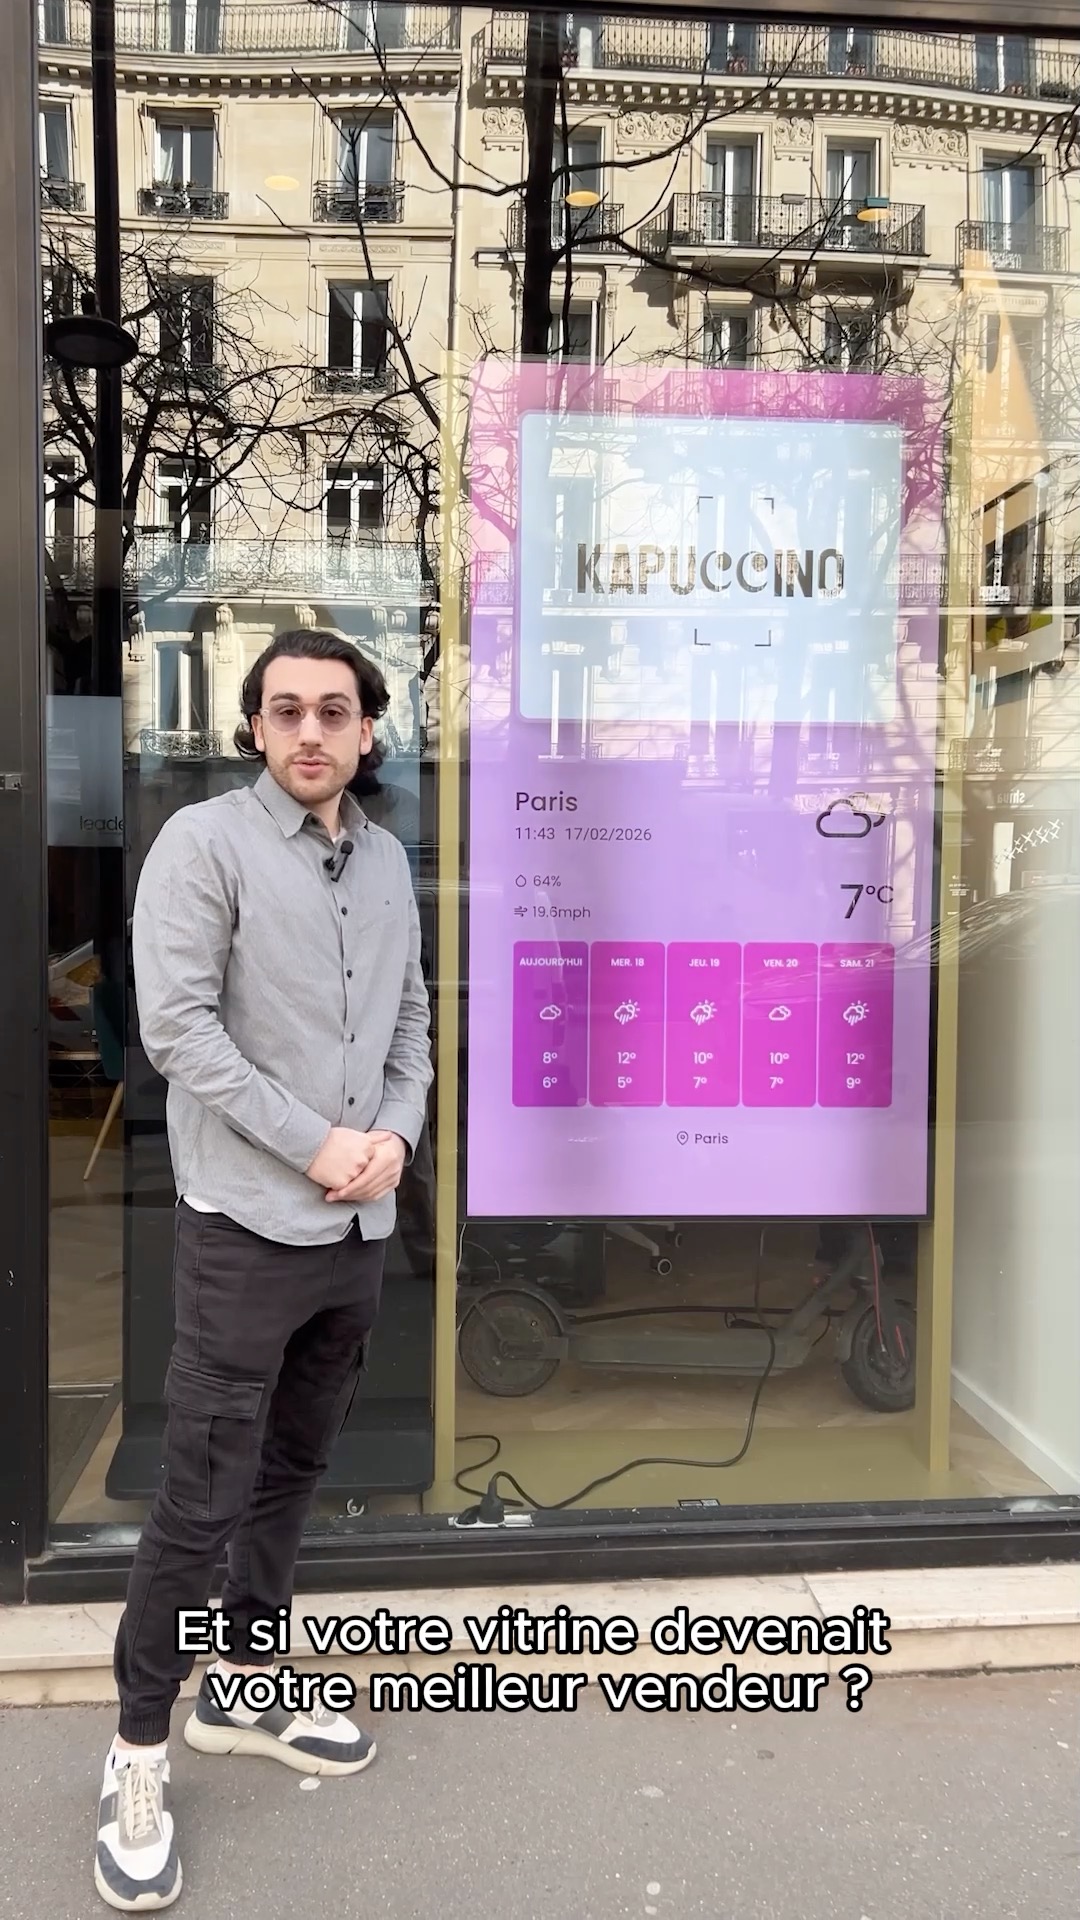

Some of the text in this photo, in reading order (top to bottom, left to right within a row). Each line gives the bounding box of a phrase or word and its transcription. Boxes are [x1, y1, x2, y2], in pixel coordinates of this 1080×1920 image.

[576, 543, 845, 598] KAPUCCINO
[515, 790, 579, 812] Paris
[515, 827, 652, 842] 11:43 17/02/2026
[532, 874, 562, 887] 64%
[532, 905, 591, 921] 19.6mph
[519, 957, 583, 967] AUJOURD'HUI
[610, 957, 645, 967] MER. 18
[688, 958, 720, 968] JEU. 19
[763, 958, 799, 968] VEN. 20
[839, 958, 875, 968] SAM. 21
[694, 1132, 729, 1144] Paris
